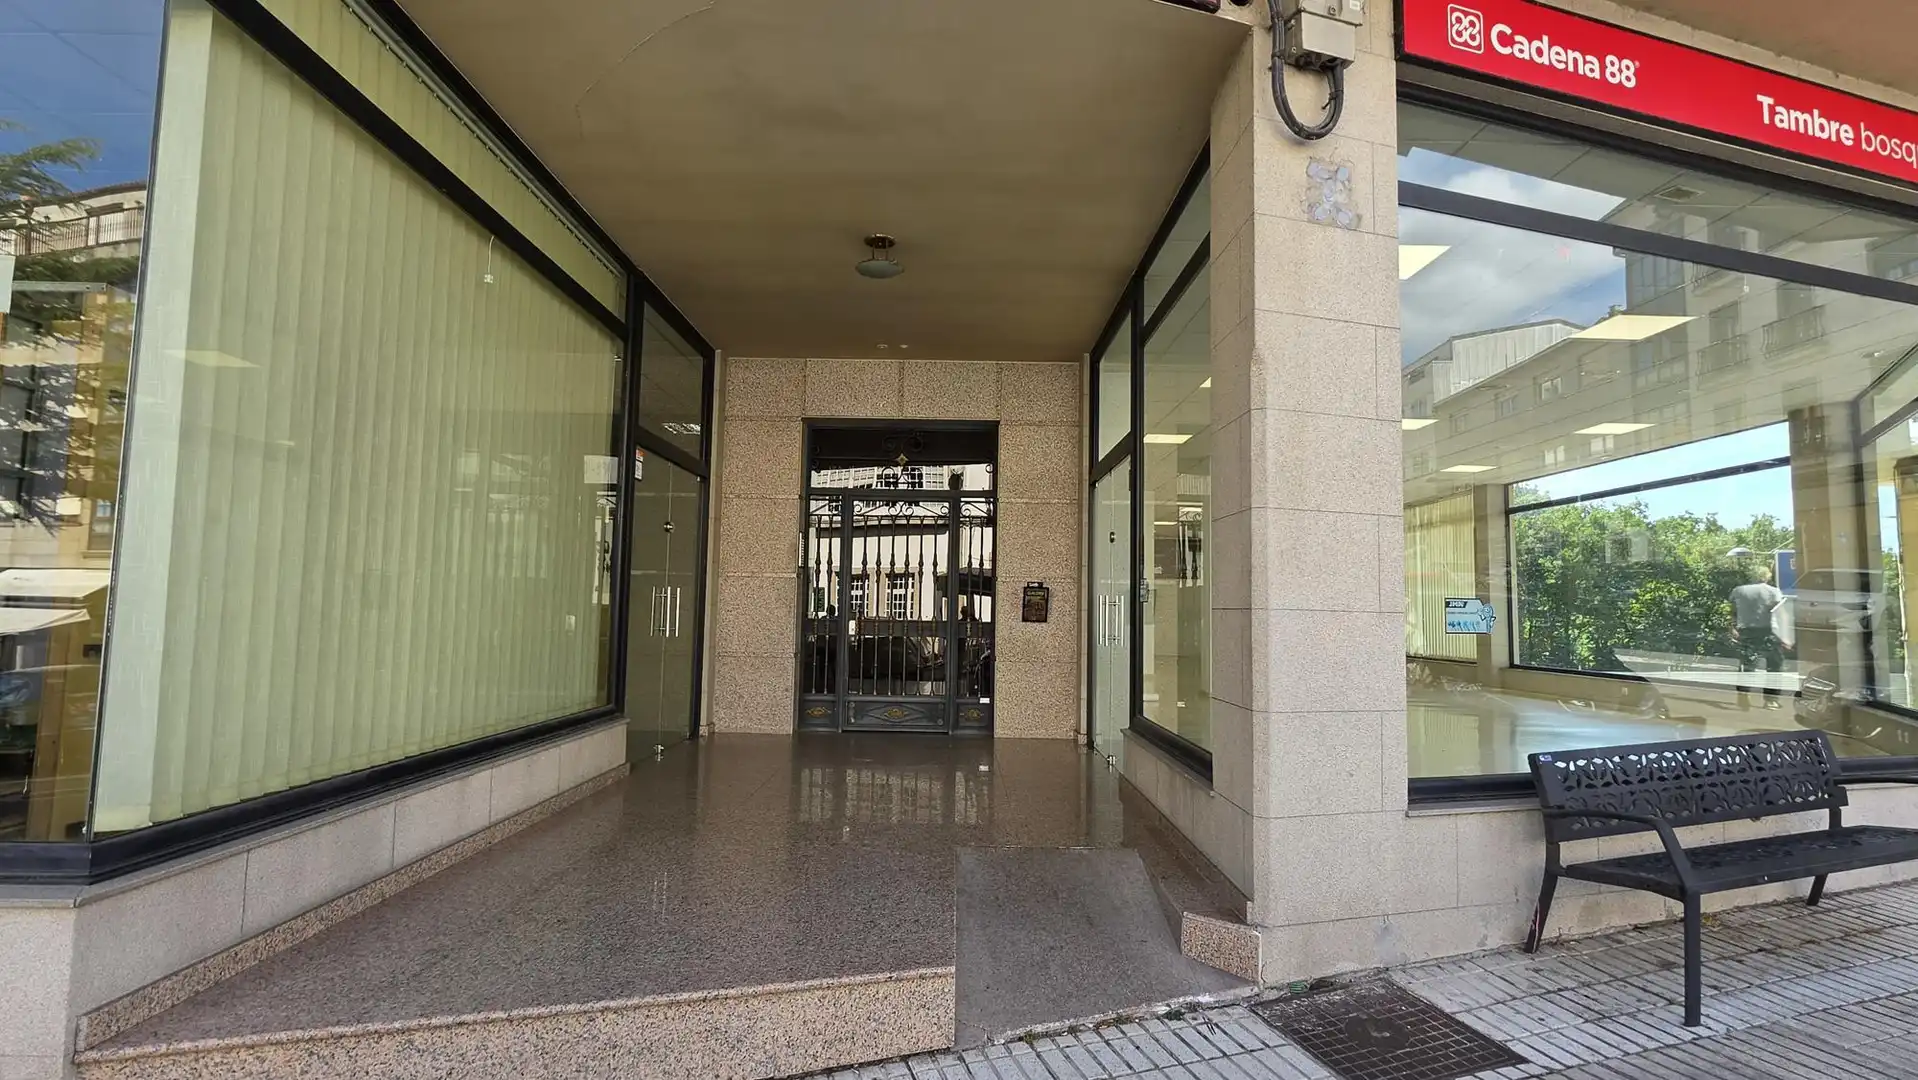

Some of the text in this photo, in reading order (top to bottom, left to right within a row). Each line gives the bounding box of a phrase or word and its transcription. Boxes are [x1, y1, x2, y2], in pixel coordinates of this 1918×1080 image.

[1490, 23, 1637, 89] Cadena 88
[1756, 93, 1918, 169] Tambre bosq
